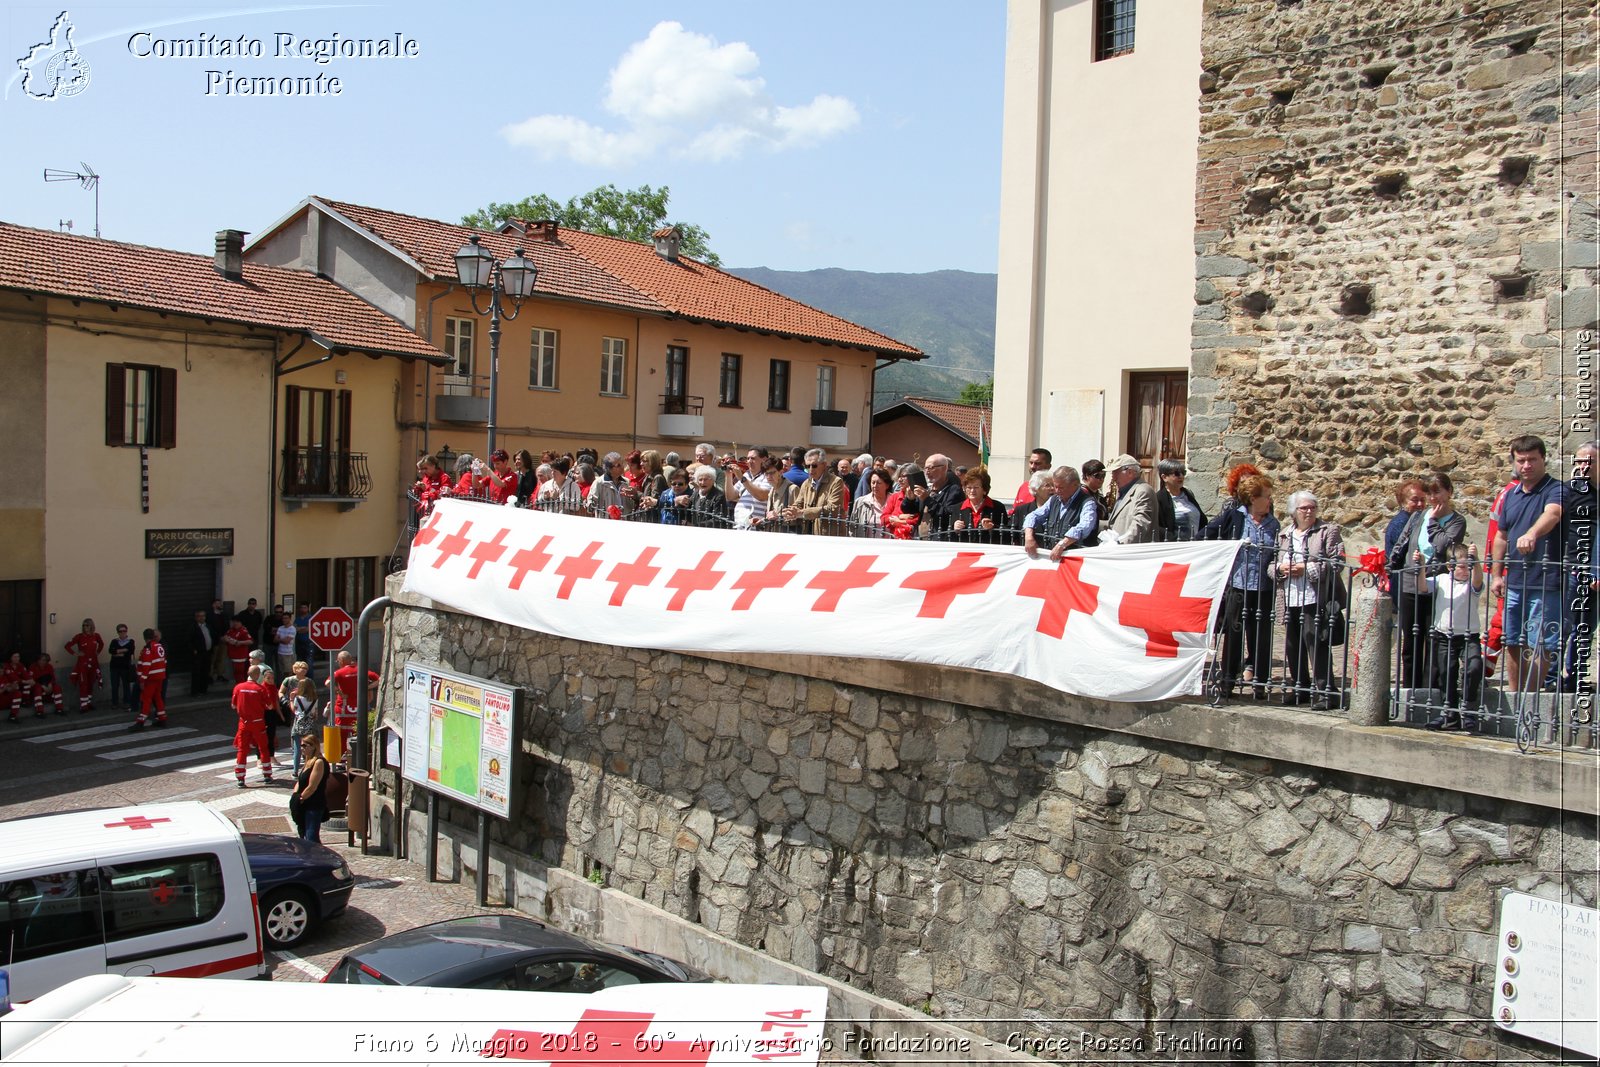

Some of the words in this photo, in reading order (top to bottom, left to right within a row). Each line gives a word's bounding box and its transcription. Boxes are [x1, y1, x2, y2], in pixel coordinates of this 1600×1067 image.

[150, 531, 230, 541] PARRUCCHIERE
[312, 621, 351, 637] STOP
[485, 698, 511, 712] FANTOLINO
[1529, 899, 1569, 919] FIANO
